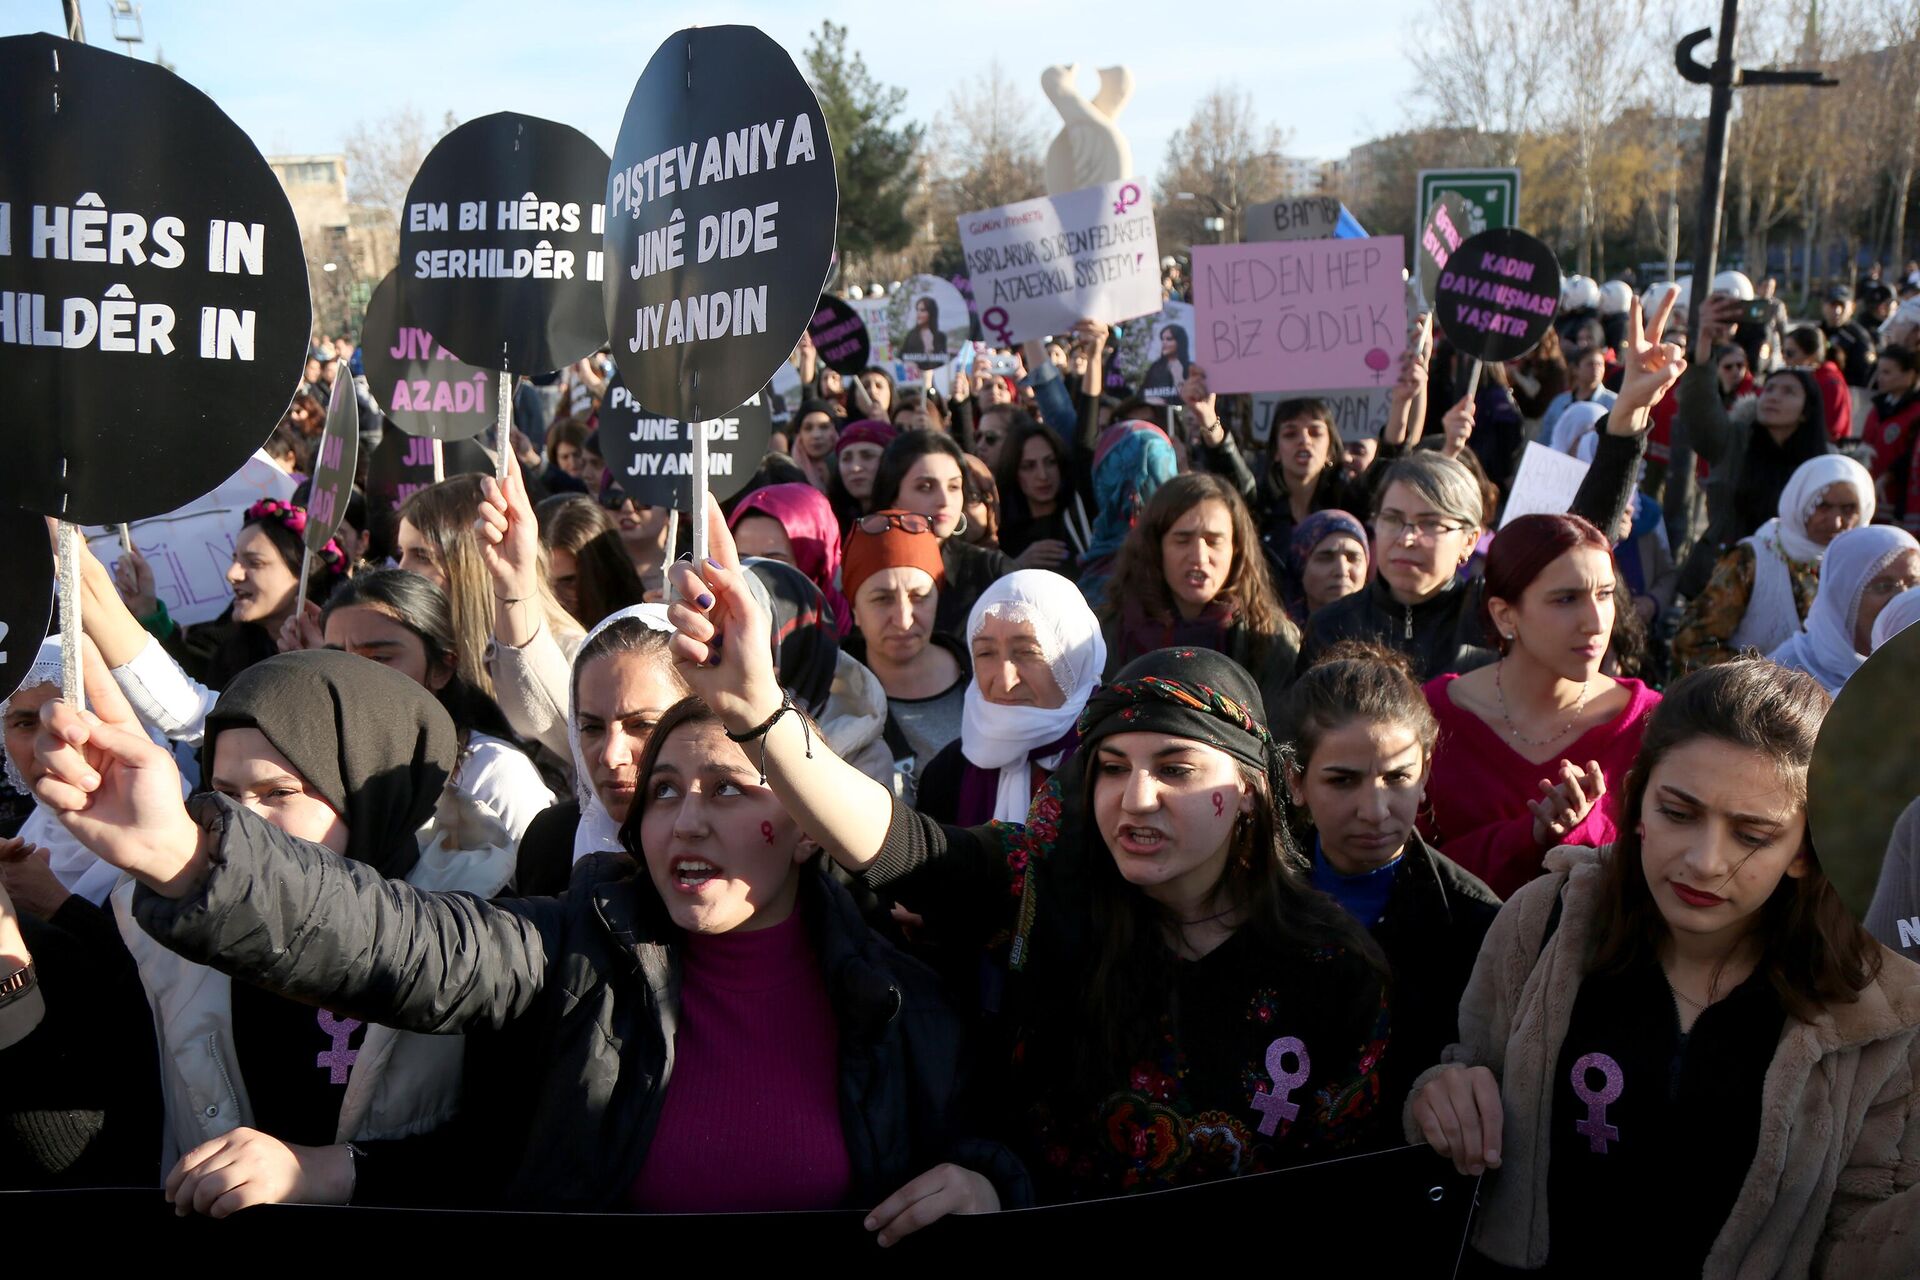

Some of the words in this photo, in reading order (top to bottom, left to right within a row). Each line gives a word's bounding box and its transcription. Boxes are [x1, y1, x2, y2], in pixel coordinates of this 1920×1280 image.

[612, 113, 816, 219] PIŞTEVANIYA
[32, 192, 185, 269] HÊRS
[208, 219, 265, 275] IN
[410, 202, 448, 232] EM
[459, 201, 487, 230] BI
[497, 191, 580, 233] HÊRS
[415, 240, 575, 280] SERHILDÊR
[630, 208, 686, 281] JINÊ
[697, 201, 779, 263] DIDE
[1206, 252, 1315, 308] NEDEN
[1325, 246, 1382, 291] HEP
[1481, 252, 1535, 281] KADIN
[1440, 272, 1556, 316] DAYANIŞMASI
[200, 306, 256, 361] IN
[628, 285, 768, 354] JIYANDIN
[1456, 304, 1528, 338] YAŞATIR
[391, 371, 488, 413] AZADÎ
